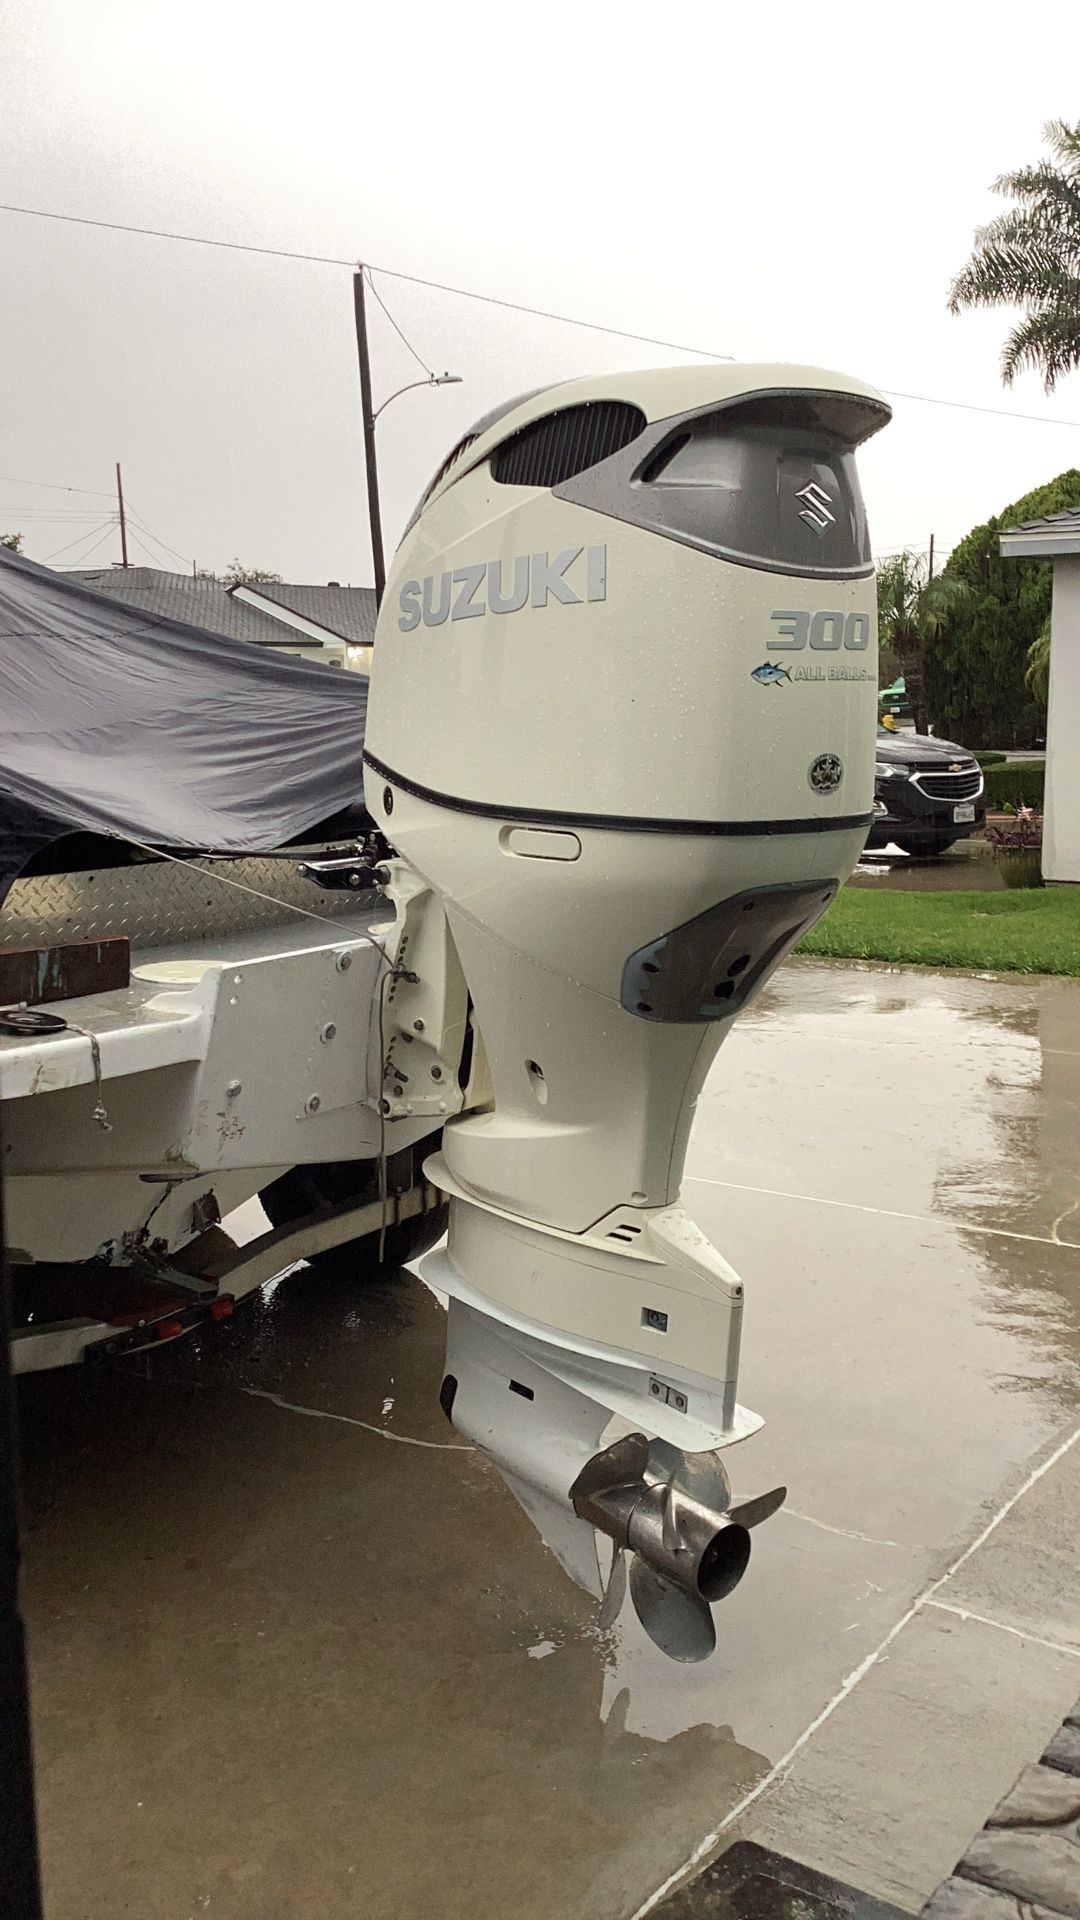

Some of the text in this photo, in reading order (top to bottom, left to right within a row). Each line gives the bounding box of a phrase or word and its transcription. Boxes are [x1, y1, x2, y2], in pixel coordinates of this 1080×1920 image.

[398, 543, 607, 633] SUZUKI
[766, 610, 870, 651] 300
[794, 665, 826, 681] ALL
[827, 665, 867, 681] BALLS
